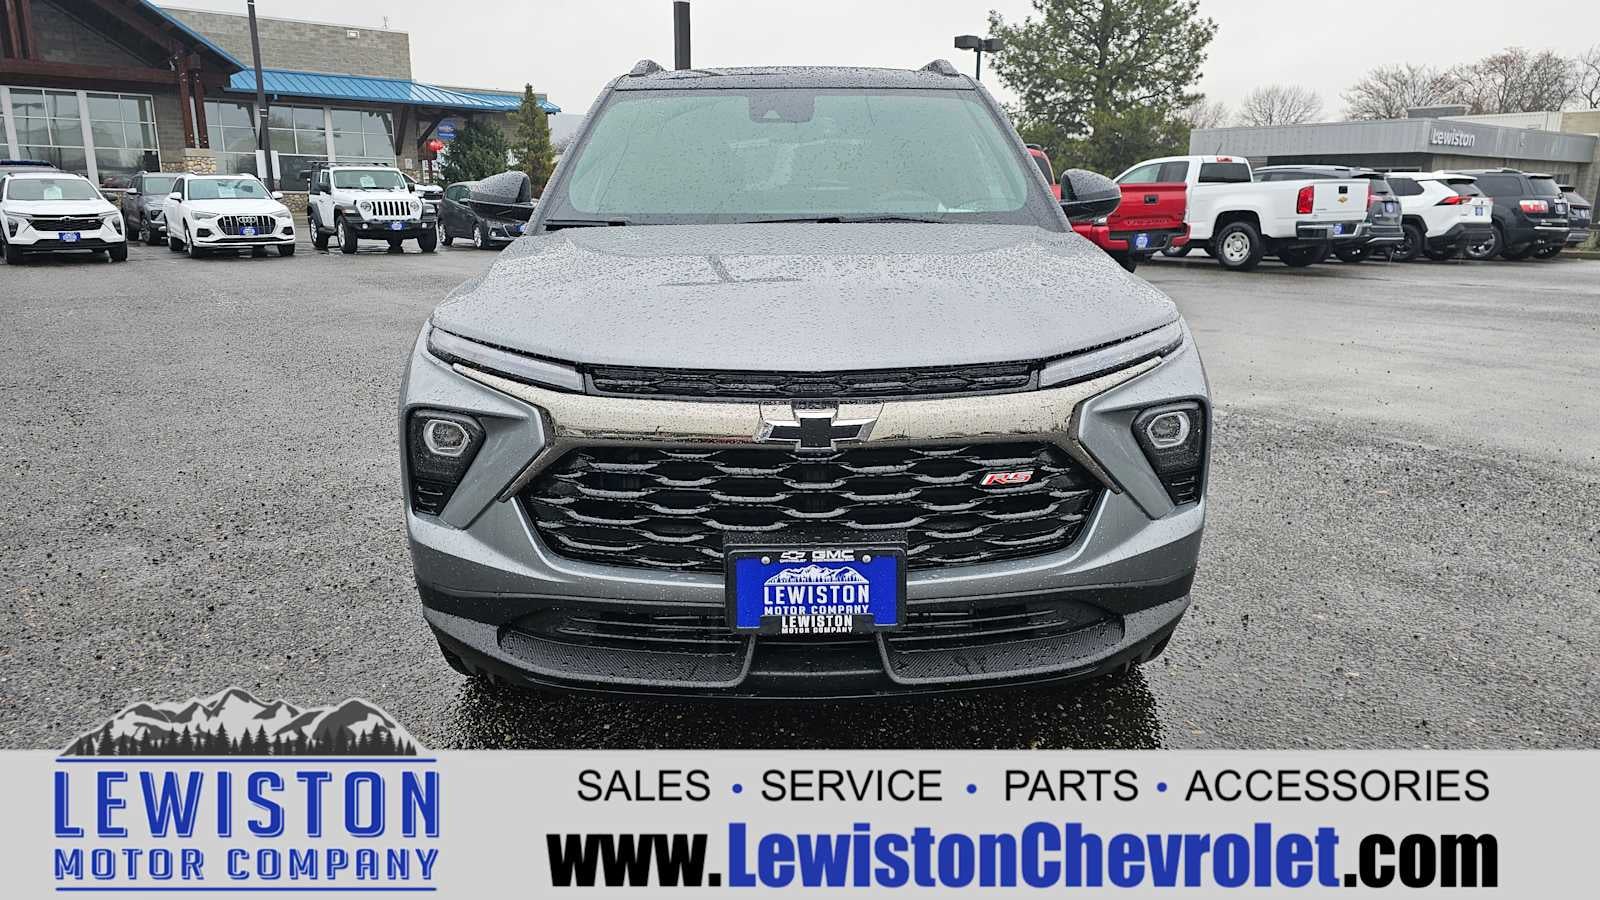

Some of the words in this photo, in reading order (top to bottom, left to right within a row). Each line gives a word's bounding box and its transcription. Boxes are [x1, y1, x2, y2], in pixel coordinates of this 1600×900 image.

[1431, 127, 1475, 147] Lewiston
[981, 471, 1033, 485] RS
[812, 550, 855, 559] GMC
[764, 585, 870, 605] LEWISTON
[764, 606, 806, 616] MOTOR
[811, 605, 869, 615] COMPANY
[781, 615, 853, 628] LEWISTON
